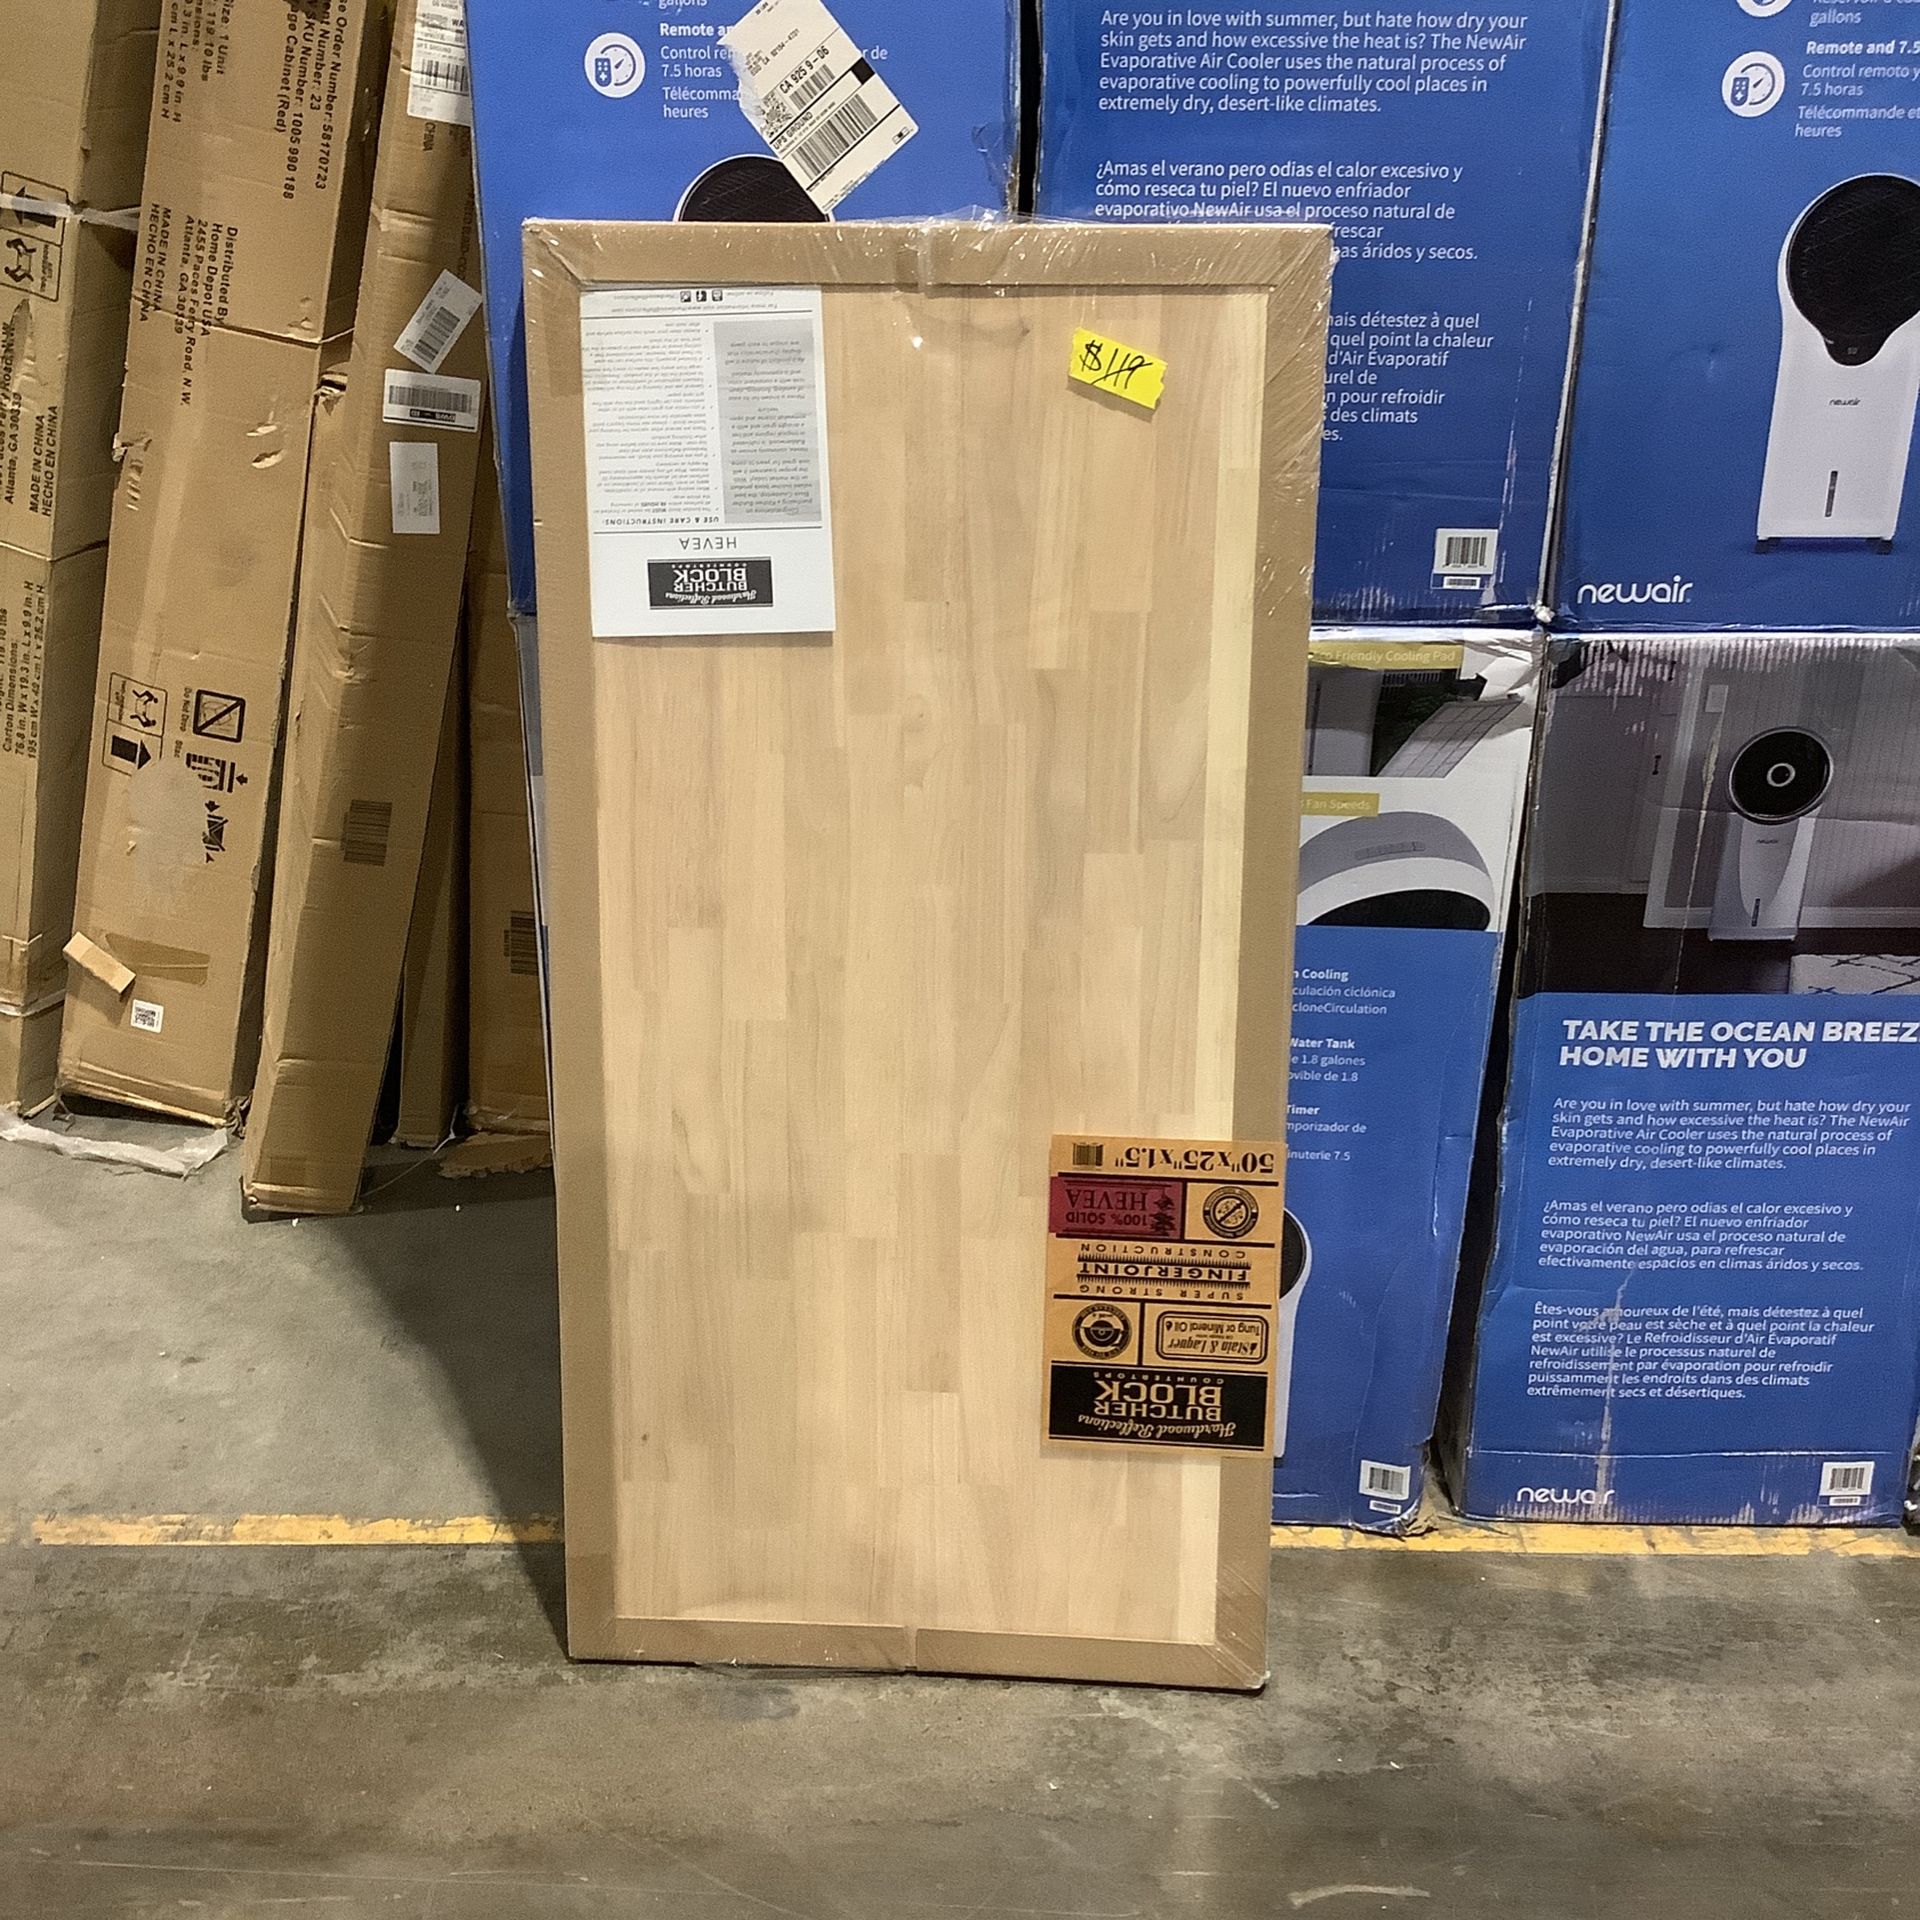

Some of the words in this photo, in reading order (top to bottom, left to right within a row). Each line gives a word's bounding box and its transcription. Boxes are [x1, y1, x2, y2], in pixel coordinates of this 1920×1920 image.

[1101, 10, 1128, 25] Are
[1133, 13, 1162, 29] you
[1168, 11, 1182, 25] in
[1188, 10, 1221, 26] love
[1226, 11, 1261, 26] with
[1266, 13, 1338, 29] summer,
[1343, 11, 1371, 27] but
[1375, 11, 1412, 28] hate
[1417, 12, 1452, 28] how
[1457, 12, 1484, 32] dry
[1488, 15, 1527, 33] your
[1809, 9, 1861, 27] gallons
[332, 17, 347, 58] Order
[660, 23, 714, 36] Remote
[1101, 31, 1134, 47] skin
[1138, 34, 1172, 50] gets
[1176, 31, 1207, 47] and
[1212, 31, 1247, 48] how
[1251, 34, 1328, 48] excessive
[1332, 34, 1359, 48] the
[1364, 34, 1400, 49] heat
[1405, 34, 1426, 49] is?
[1431, 34, 1461, 49] The
[1466, 34, 1526, 49] NewAir
[1807, 41, 1862, 54] Remote
[1867, 40, 1895, 54] and
[312, 29, 330, 89] Number:
[660, 46, 711, 59] Control
[871, 47, 888, 60] de
[280, 35, 298, 91] Cabinet
[662, 64, 682, 77] 7.5
[684, 64, 722, 78] horas
[1803, 64, 1856, 78] Control
[1858, 66, 1909, 77] remoto
[295, 46, 311, 107] Number:
[779, 80, 794, 94] CA
[790, 66, 807, 86] 925
[1801, 83, 1821, 96] 7.5
[1825, 83, 1863, 96] horas
[310, 94, 321, 111] 23
[275, 94, 289, 133] (Red)
[663, 106, 708, 118] heures
[1798, 105, 1905, 119] Télécommande
[290, 113, 303, 144] 1005
[772, 135, 788, 150] UPS
[786, 111, 813, 141] GROUND
[1795, 124, 1842, 137] heures
[287, 147, 299, 172] 990
[315, 124, 333, 190] 58170723
[1096, 160, 1147, 179] ¿Amas
[1152, 160, 1165, 176] el
[1170, 163, 1224, 176] verano
[1229, 164, 1265, 179] pero
[1270, 161, 1313, 177] odias
[1317, 161, 1332, 177] el
[1336, 162, 1377, 177] calor
[1381, 163, 1448, 178] excesivo
[1452, 166, 1463, 182] y
[283, 177, 295, 199] 188
[146, 203, 160, 254] HECHO
[159, 207, 172, 248] MADE
[196, 219, 208, 251] 2455
[180, 215, 194, 267] Atlanta,
[208, 223, 223, 262] Home
[143, 258, 154, 276] EN
[158, 251, 168, 265] IN
[219, 227, 238, 304] Distributed
[179, 273, 188, 292] GA
[191, 255, 204, 294] Paces
[153, 269, 165, 311] CHINA
[203, 266, 218, 305] Depot
[140, 279, 151, 322] CHINA
[201, 309, 212, 336] USA
[1330, 331, 1364, 346] quel
[1369, 333, 1410, 349] point
[1415, 332, 1428, 346] la
[1433, 333, 1494, 347] chaleur
[182, 336, 196, 374] Road,
[1328, 351, 1363, 365] d'Air
[1368, 349, 1449, 369] Évaporatif
[1080, 340, 1148, 389] $119
[10, 392, 22, 430] 30339
[33, 415, 44, 456] CHINA
[46, 406, 57, 447] CHINA
[8, 434, 18, 452] GA
[32, 458, 41, 472] IN
[45, 450, 55, 468] EN
[29, 476, 42, 513] MADE
[42, 470, 55, 516] HECHO
[670, 517, 691, 525] CARE
[679, 537, 737, 550] HEVEA
[674, 568, 747, 582] BLOCK
[674, 582, 747, 592] BUTCHER
[1577, 575, 1693, 603] newair
[666, 592, 709, 605] Reflections
[710, 589, 757, 604] Hardwood
[1336, 650, 1383, 664] Friendly
[1385, 651, 1429, 665] Cooling
[1433, 652, 1456, 662] Pad
[1307, 799, 1328, 809] Fan
[1331, 800, 1370, 810] Speeds
[1302, 969, 1349, 982] Cooling
[1344, 986, 1395, 998] ciclónica
[1563, 1020, 1639, 1041] TAKE
[1645, 1021, 1704, 1042] THE
[1711, 1021, 1815, 1042] OCEAN
[1822, 1022, 1920, 1042] BREEZ
[1326, 1038, 1354, 1048] Tank
[1302, 1055, 1318, 1064] 1.8
[1321, 1056, 1365, 1067] galones
[1559, 1047, 1649, 1066] HOME
[1655, 1048, 1735, 1068] WITH
[1745, 1049, 1807, 1068] YOU
[1066, 1189, 1147, 1211] HEVEA
[1066, 1211, 1106, 1224] SOLID
[1112, 1214, 1147, 1227] 100%
[1081, 1243, 1246, 1259] CONSTRUCTION
[1080, 1263, 1247, 1281] FINGERJOINT
[1538, 1255, 1636, 1269] efectivamente
[1638, 1259, 1696, 1270] espacios
[1699, 1259, 1715, 1269] en
[1719, 1258, 1762, 1269] climas
[1766, 1258, 1808, 1270] áridos
[1811, 1261, 1819, 1272] y
[1822, 1260, 1864, 1270] secos.
[1080, 1285, 1162, 1296] STRONG
[1180, 1290, 1243, 1300] SUPER
[1174, 1321, 1187, 1332] Oil
[1190, 1322, 1223, 1333] Mineral
[1226, 1324, 1236, 1333] or
[1239, 1324, 1260, 1336] Tung
[1210, 1342, 1219, 1354] &
[1221, 1342, 1253, 1356] Stain
[1093, 1372, 1224, 1384] COUNTERTOPS
[1096, 1381, 1222, 1406] BLOCK
[1094, 1402, 1221, 1422] BUTCHER
[1078, 1414, 1154, 1438] Reflections
[1156, 1422, 1236, 1438] Hardwood
[1517, 1485, 1615, 1504] newar
